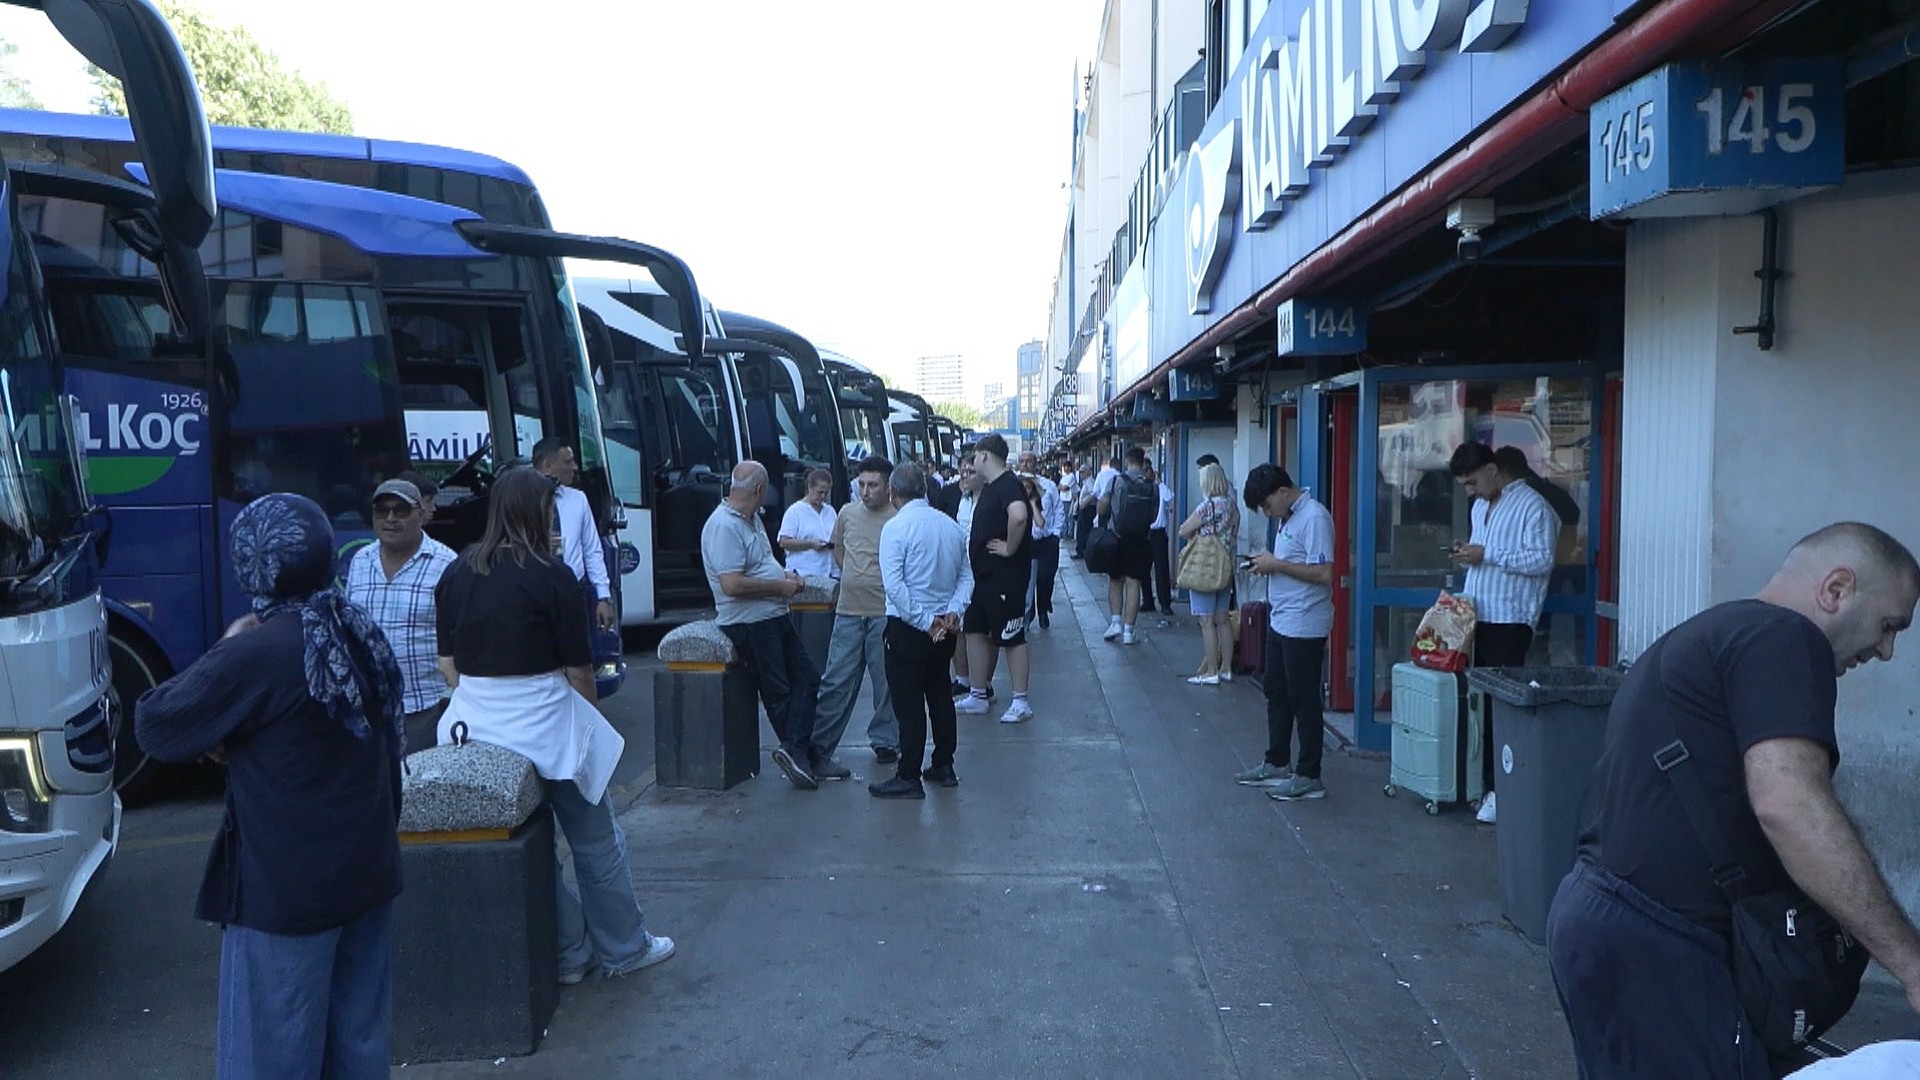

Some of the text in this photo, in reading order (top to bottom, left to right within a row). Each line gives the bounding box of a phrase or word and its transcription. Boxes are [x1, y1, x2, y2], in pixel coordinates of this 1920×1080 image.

[1695, 84, 1817, 154] 145
[1601, 101, 1655, 183] 145
[1304, 308, 1356, 339] 144
[1063, 374, 1078, 393] 138
[160, 392, 202, 409] 1926
[1064, 406, 1078, 426] 139
